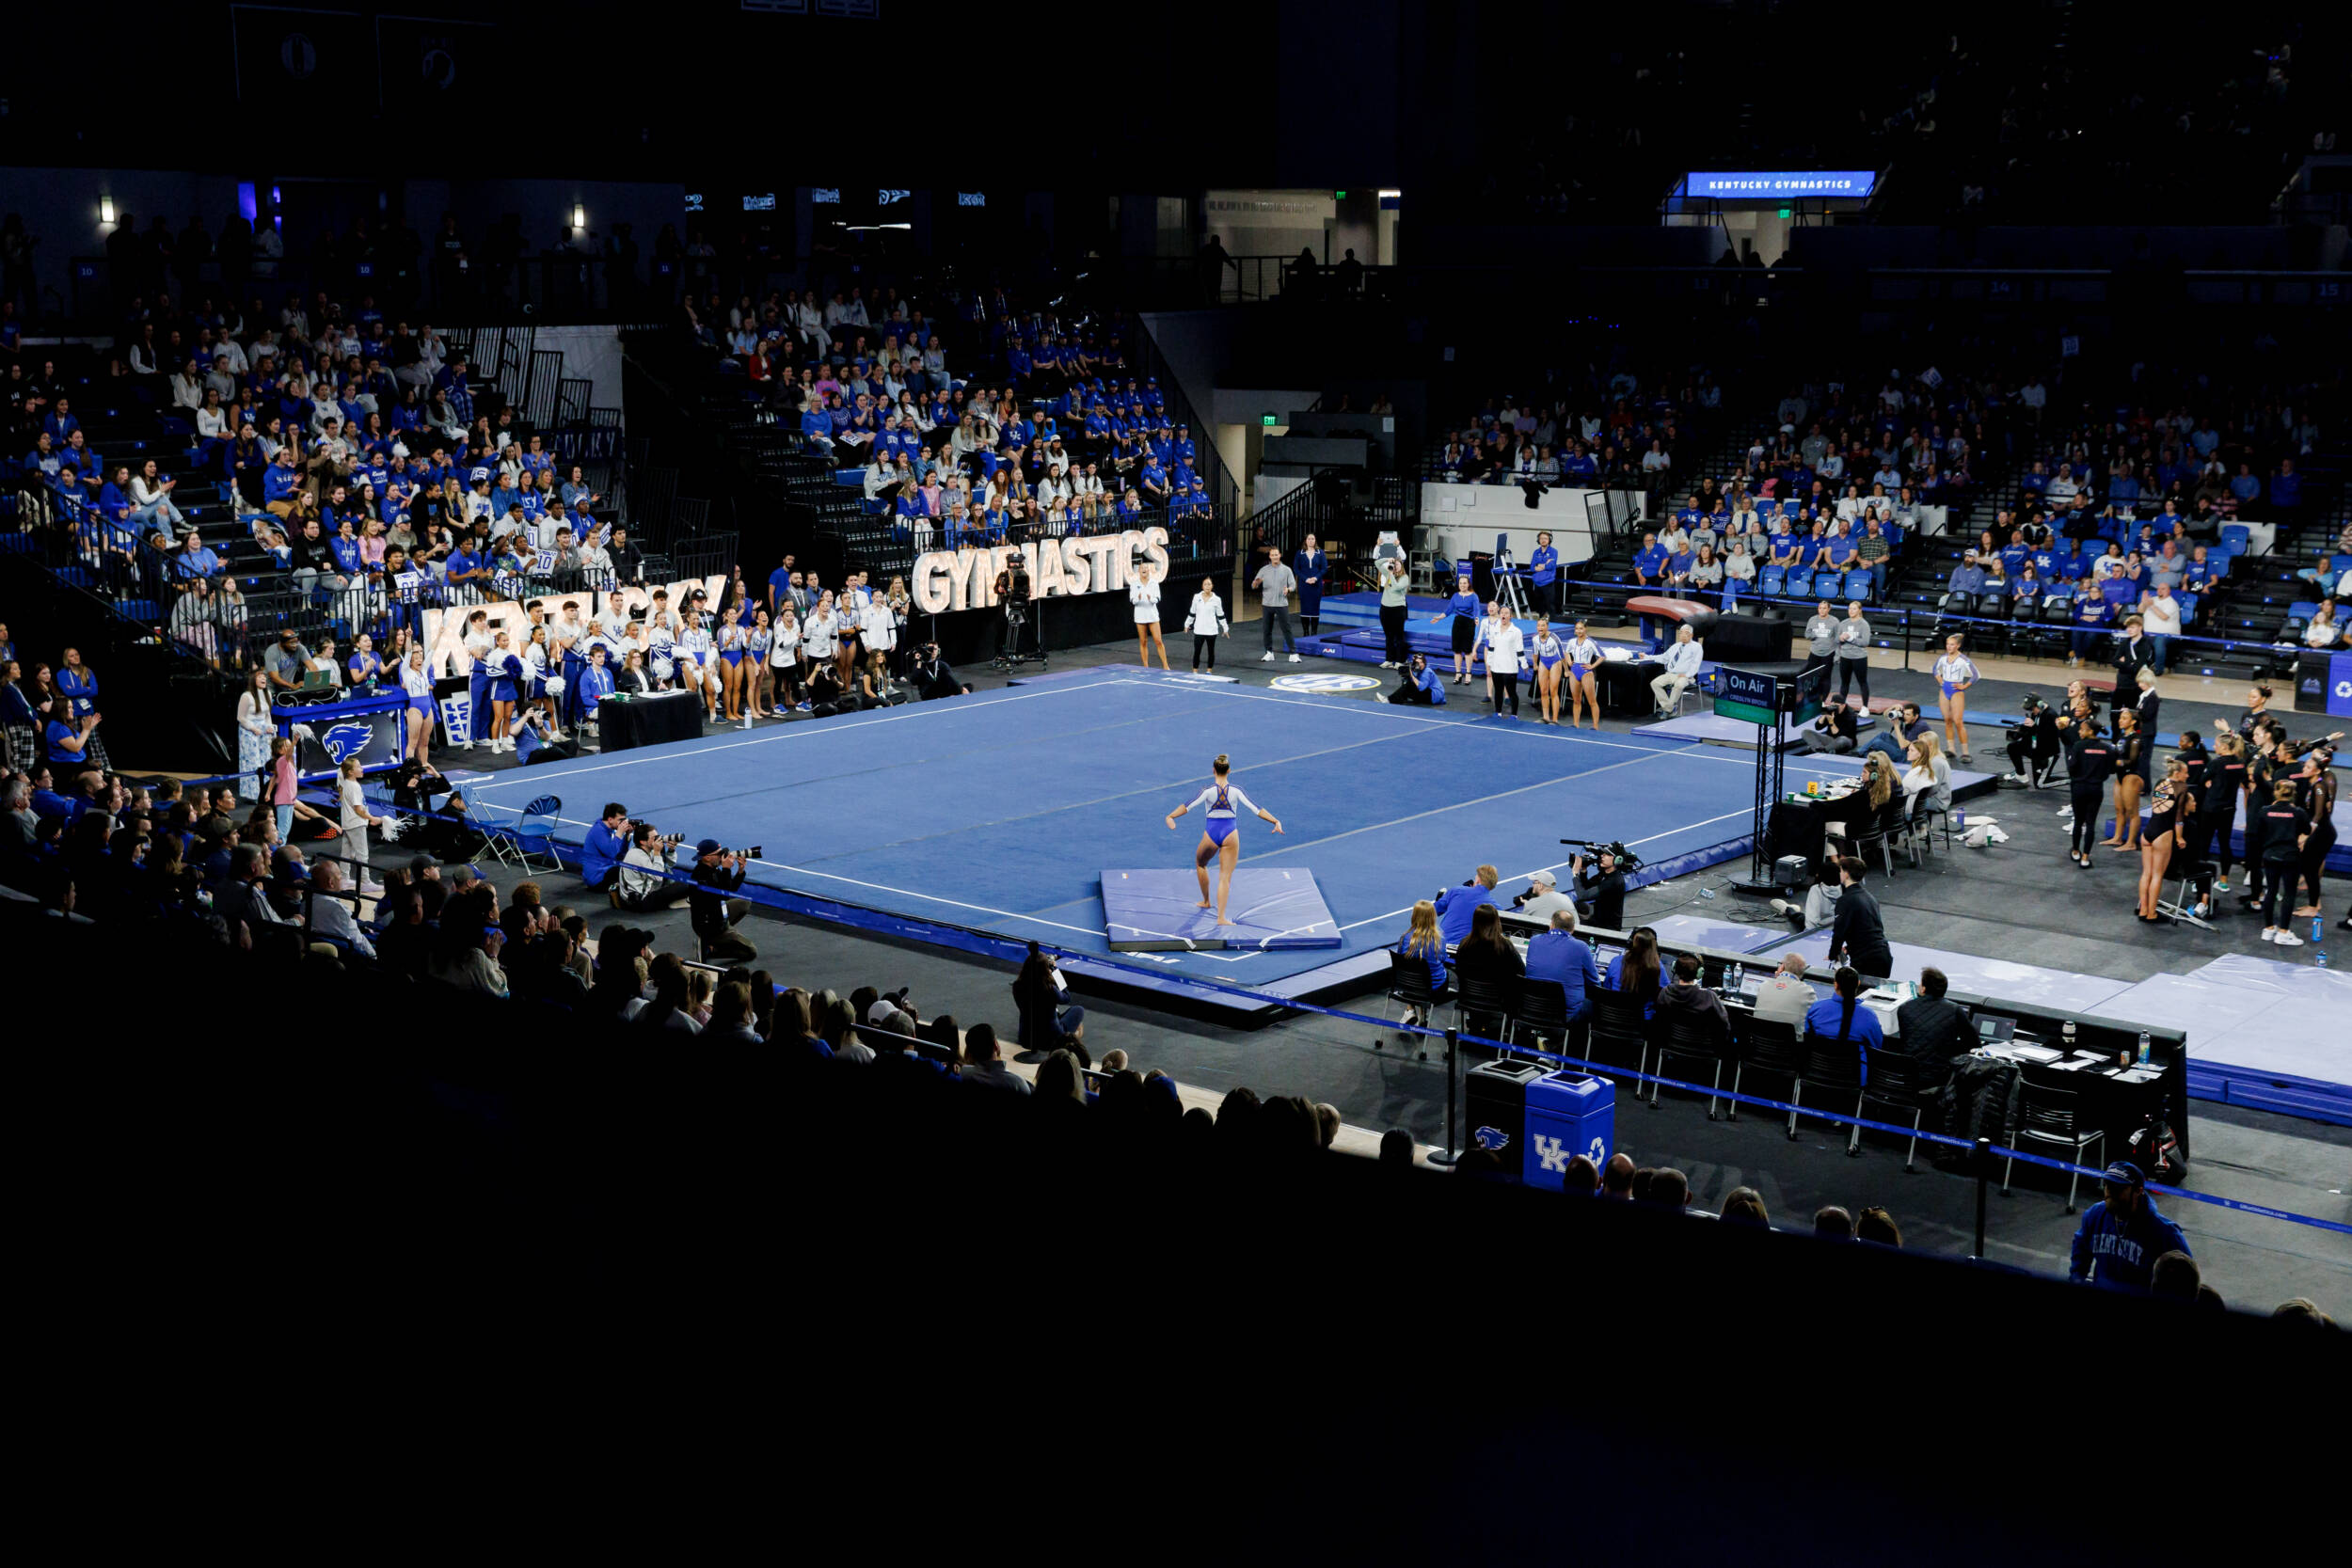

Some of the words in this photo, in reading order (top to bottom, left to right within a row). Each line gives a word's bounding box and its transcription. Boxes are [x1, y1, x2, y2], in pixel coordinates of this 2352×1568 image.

[1709, 181, 1771, 190] KENTUCKY
[1775, 180, 1852, 190] GYMNASTICS
[537, 555, 552, 570] 10
[1730, 675, 1746, 689] On
[1748, 678, 1765, 693] Air
[1534, 1133, 1570, 1174] UK
[2091, 1233, 2144, 1267] KENTUCKY
